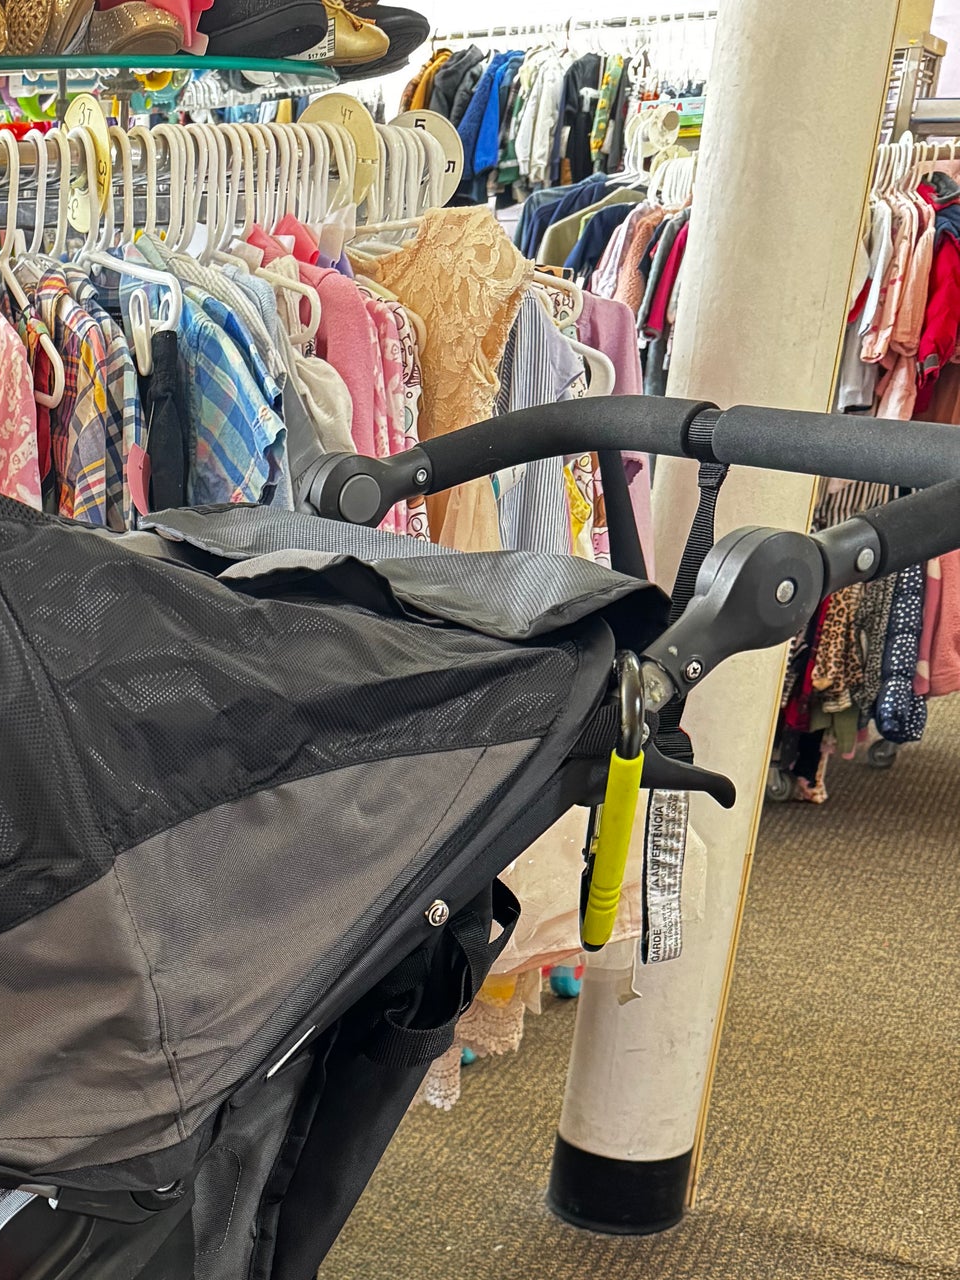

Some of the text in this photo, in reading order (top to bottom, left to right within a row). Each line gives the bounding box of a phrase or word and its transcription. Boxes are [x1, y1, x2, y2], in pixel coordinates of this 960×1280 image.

[78, 102, 93, 126] 3T
[651, 805, 664, 878] ADVERTENCIA
[651, 928, 662, 962] GARDE
